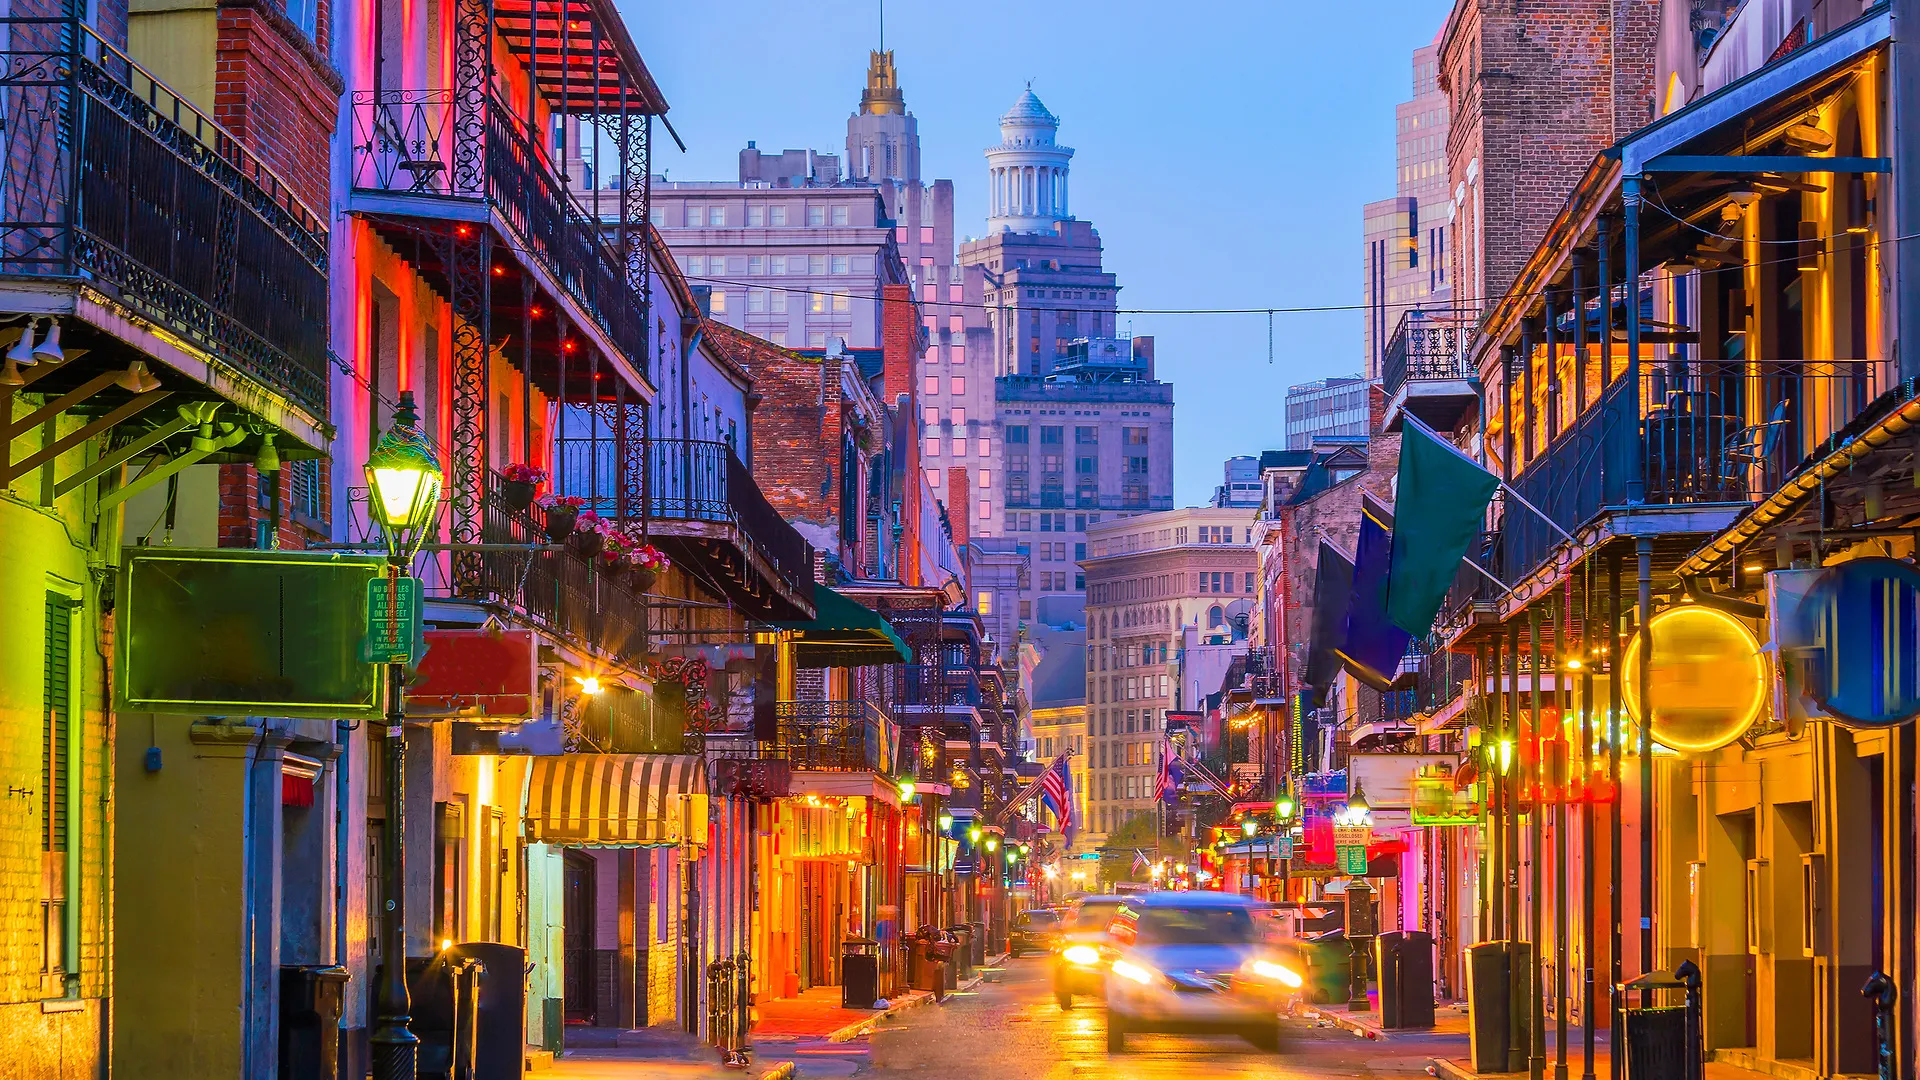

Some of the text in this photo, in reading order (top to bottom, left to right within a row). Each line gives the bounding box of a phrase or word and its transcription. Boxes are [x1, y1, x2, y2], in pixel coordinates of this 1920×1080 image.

[373, 585, 409, 593] NO BTLES
[376, 593, 384, 601] OR
